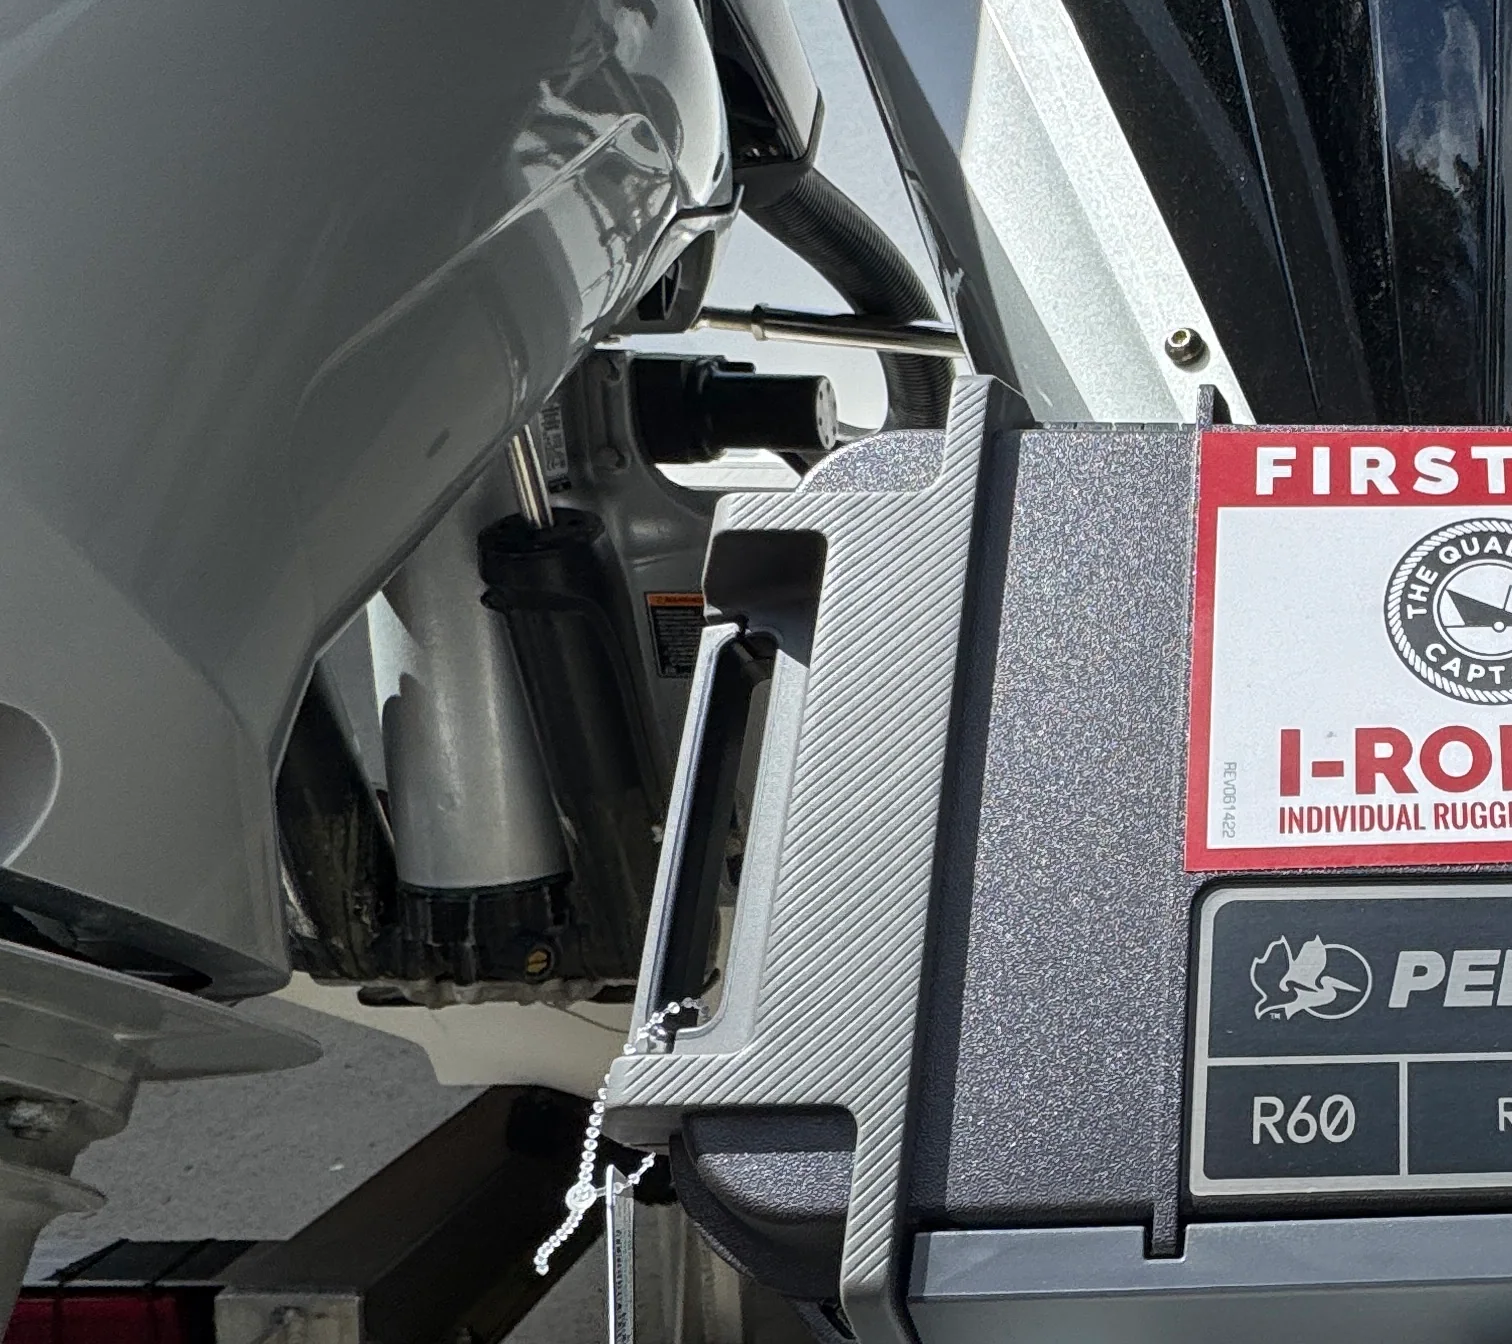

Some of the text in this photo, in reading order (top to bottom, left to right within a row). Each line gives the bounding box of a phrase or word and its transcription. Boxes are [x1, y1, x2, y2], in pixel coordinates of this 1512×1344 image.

[1407, 566, 1438, 619] THE
[1222, 761, 1237, 838] REV061422
[1279, 805, 1426, 834] INDIVIDUAL
[1252, 1094, 1356, 1144] R60
